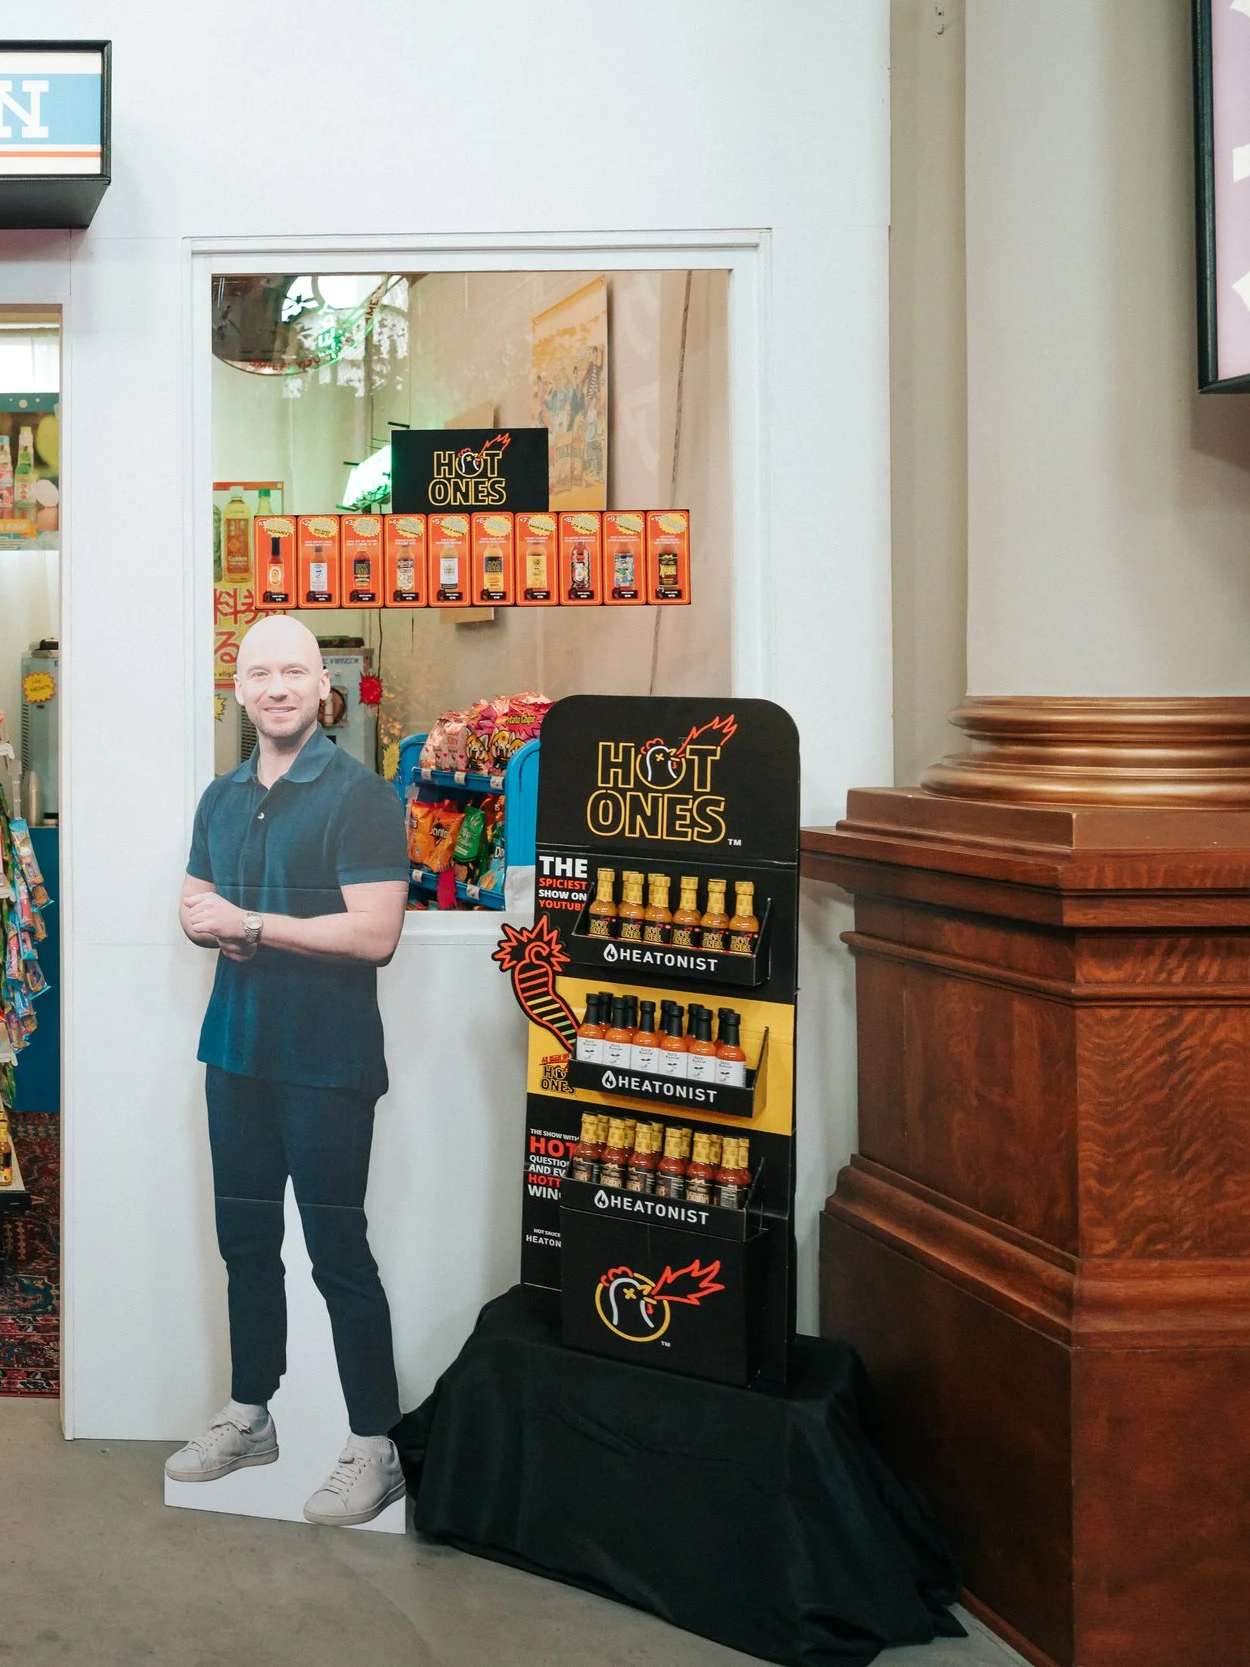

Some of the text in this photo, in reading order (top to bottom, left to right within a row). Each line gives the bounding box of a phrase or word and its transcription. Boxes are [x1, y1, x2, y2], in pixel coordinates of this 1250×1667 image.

[434, 450, 503, 478] HOT
[428, 478, 507, 506] ONES
[598, 741, 721, 792] HOT
[586, 789, 742, 846] ONES TM
[538, 855, 588, 879] THE
[538, 878, 588, 891] SPICIEST
[538, 889, 588, 901] SHOW ON
[620, 948, 719, 972] HEATONIST
[543, 1064, 567, 1081] HO
[618, 1075, 718, 1103] HEATONIST
[530, 1128, 542, 1136] THE
[543, 1130, 563, 1139] SHOW
[529, 1135, 578, 1159] HOT
[529, 1154, 570, 1168] QUESTIO
[529, 1164, 567, 1179] AND EV
[527, 1173, 563, 1189] HOTT
[527, 1184, 562, 1201] WIN
[611, 1194, 710, 1225] HEATONIST
[525, 1234, 562, 1248] HEATON
[544, 1230, 562, 1238] SAUCE
